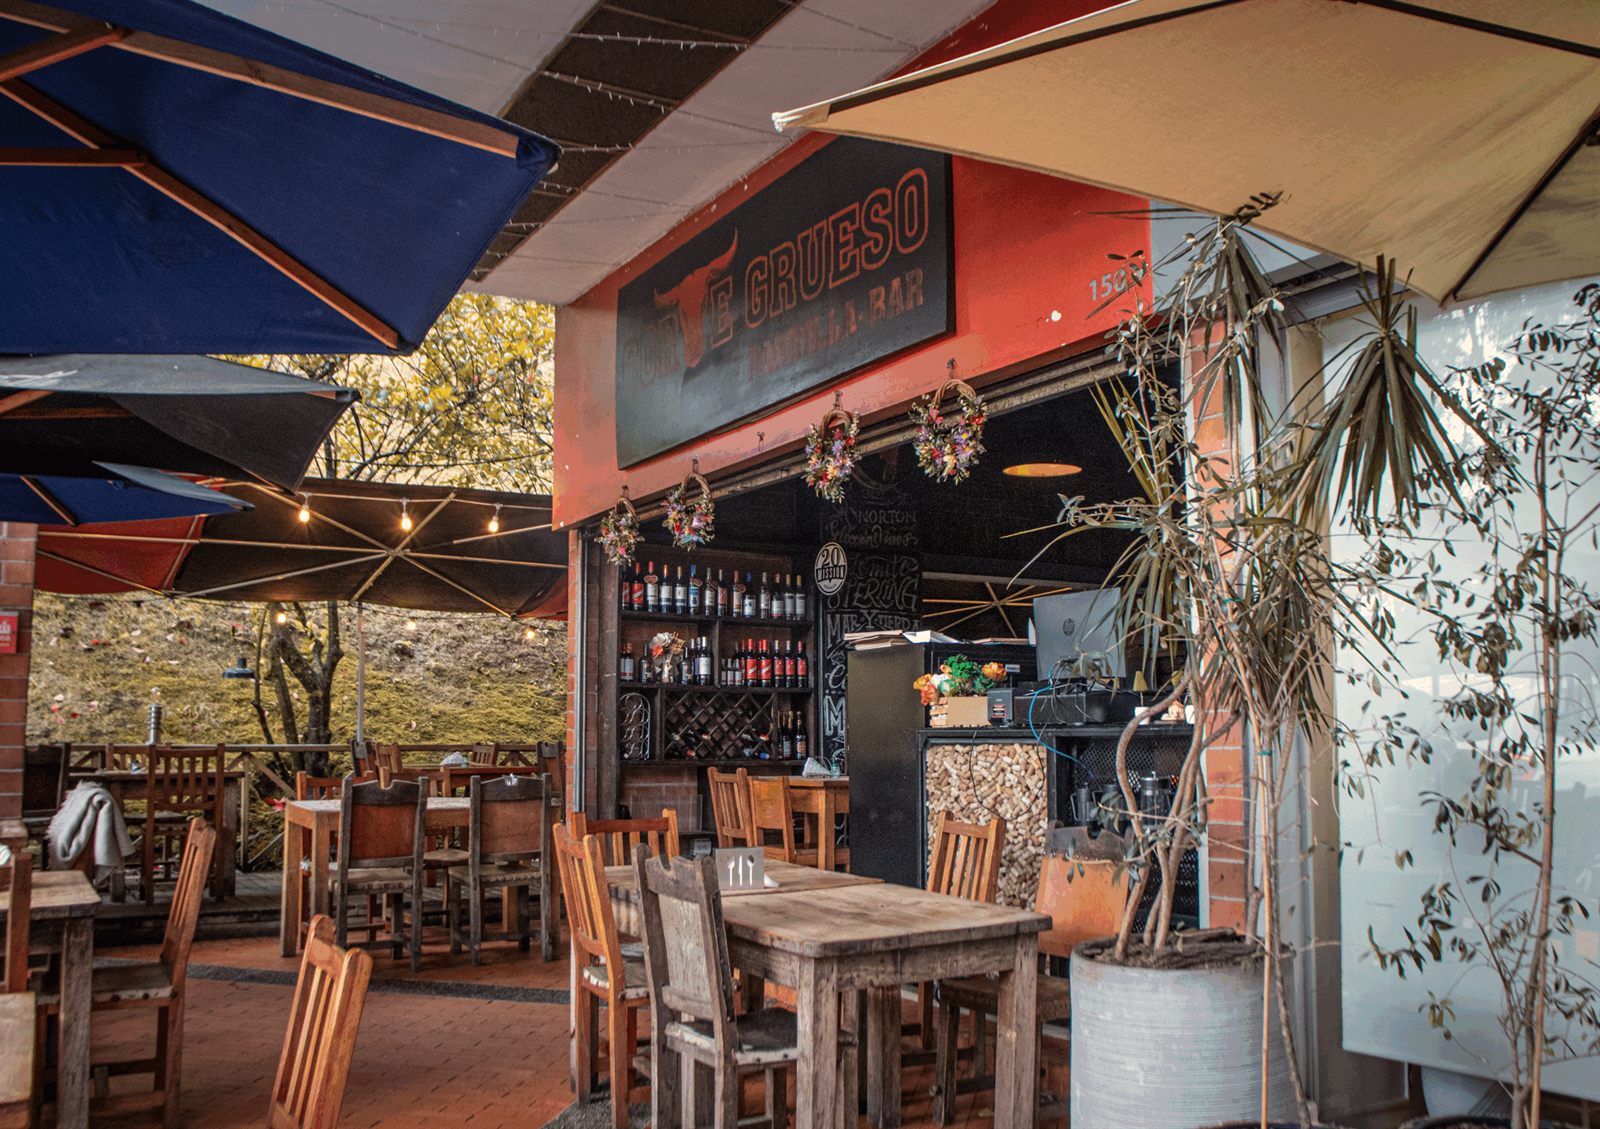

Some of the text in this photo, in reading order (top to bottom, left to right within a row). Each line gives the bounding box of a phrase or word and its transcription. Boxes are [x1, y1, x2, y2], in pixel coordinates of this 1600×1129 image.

[745, 168, 929, 328] GRUESO
[857, 510, 917, 524] NORTON
[821, 546, 840, 567] 20
